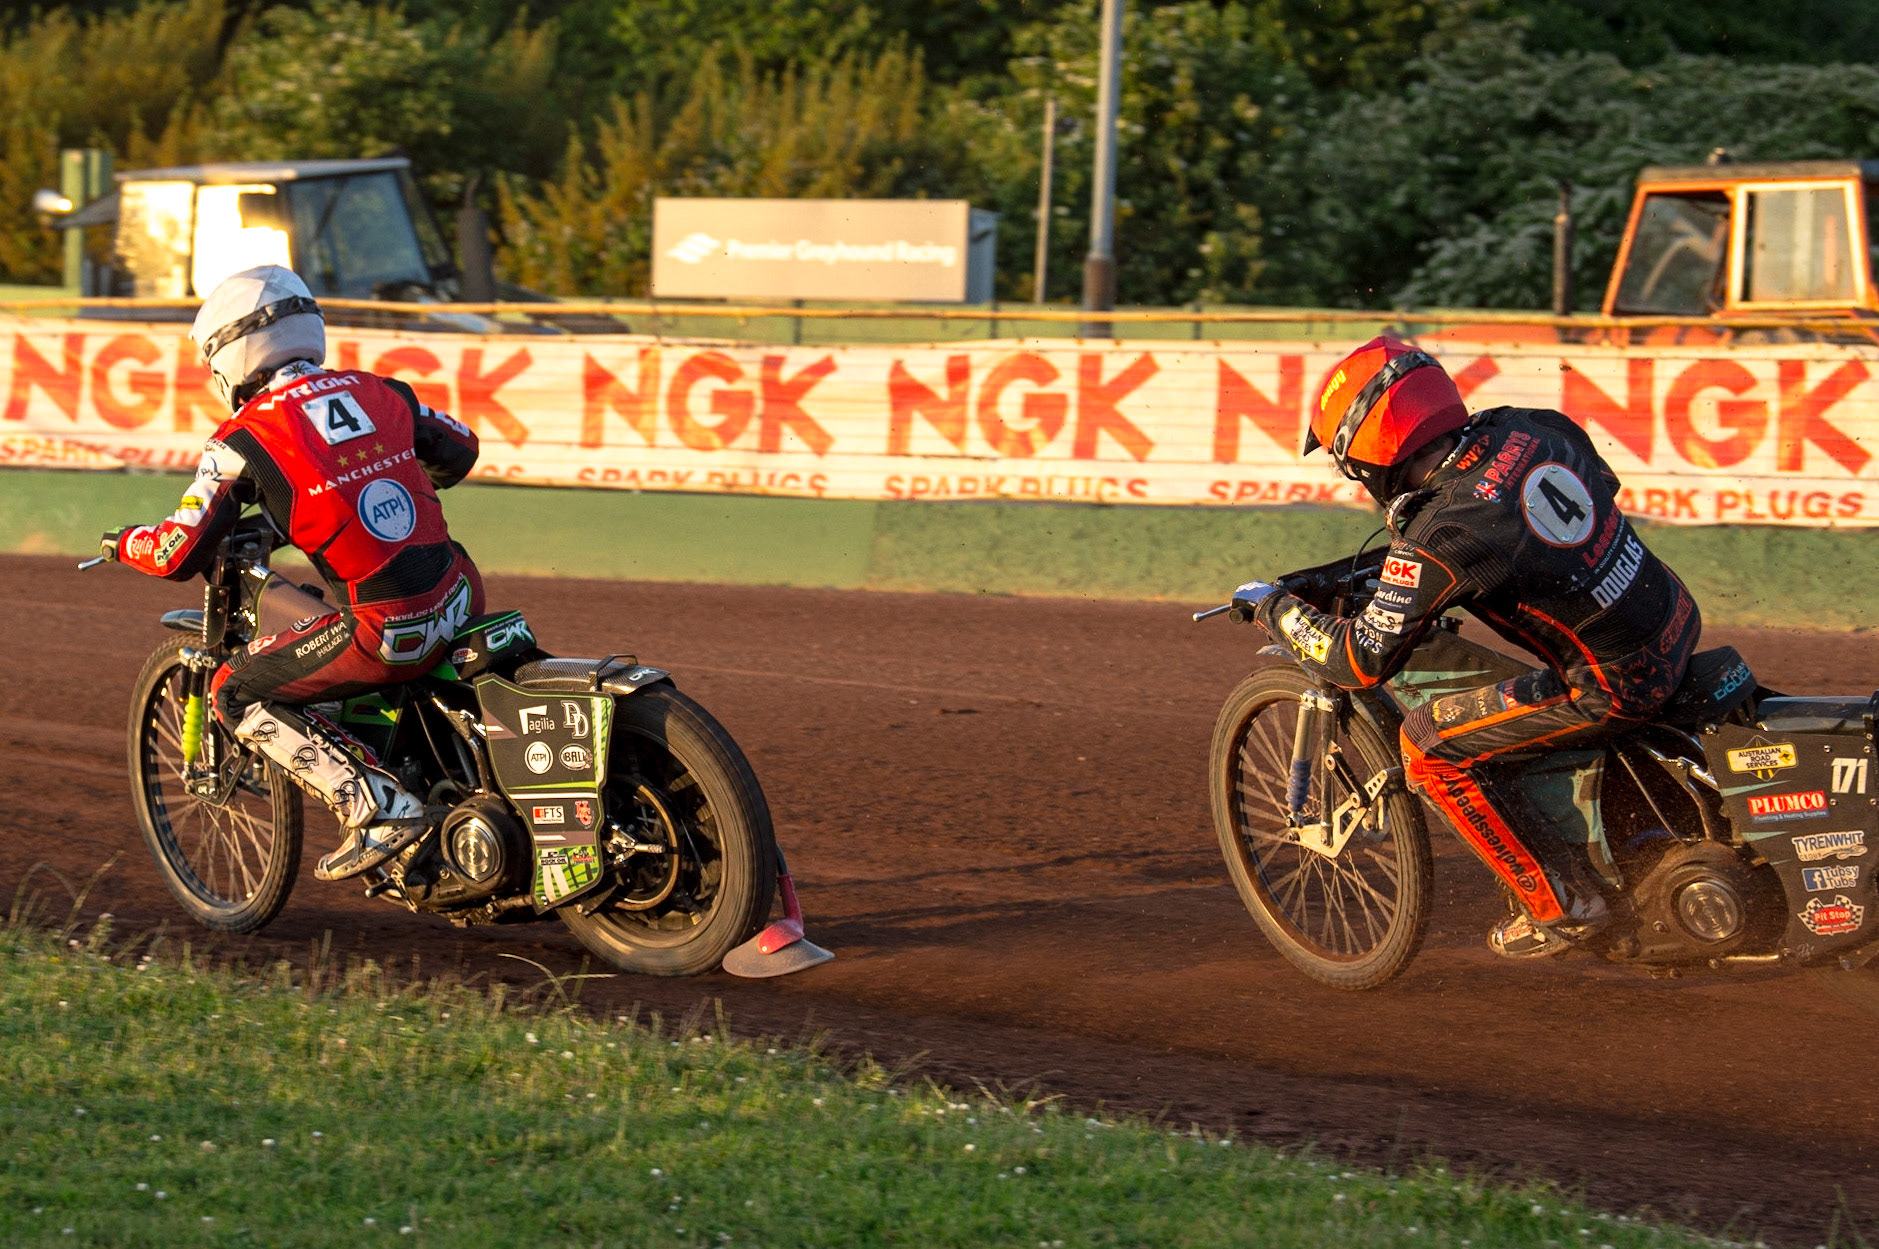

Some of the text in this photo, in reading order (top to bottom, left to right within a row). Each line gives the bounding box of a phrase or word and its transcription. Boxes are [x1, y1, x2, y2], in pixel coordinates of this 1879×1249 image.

[3, 332, 238, 433] NGK
[335, 341, 534, 450] GK
[328, 398, 361, 432] 4
[579, 346, 838, 458] NGK
[887, 351, 1161, 463] NGK
[1560, 357, 1872, 476] NGK
[1484, 430, 1531, 483] PARRYS
[1209, 480, 1343, 501] SPARK
[1538, 477, 1586, 525] 4
[1616, 487, 1868, 520] ARK PLUGS
[372, 496, 405, 524] ATPI
[1384, 560, 1417, 580] NGK
[1591, 534, 1644, 609] DOUGLAS
[295, 630, 329, 659] ROBERT
[529, 718, 555, 733] agilia
[531, 753, 547, 761] ATPI
[1738, 748, 1781, 757] AUSTRALIAN
[1746, 760, 1778, 769] SERVICES
[1831, 758, 1868, 794] 171
[544, 808, 562, 818] FTS
[1750, 793, 1825, 814] PLUMCO
[1823, 867, 1859, 878] Tubsy
[1827, 879, 1856, 888] Tubs
[1814, 910, 1852, 921] Pit Stop
